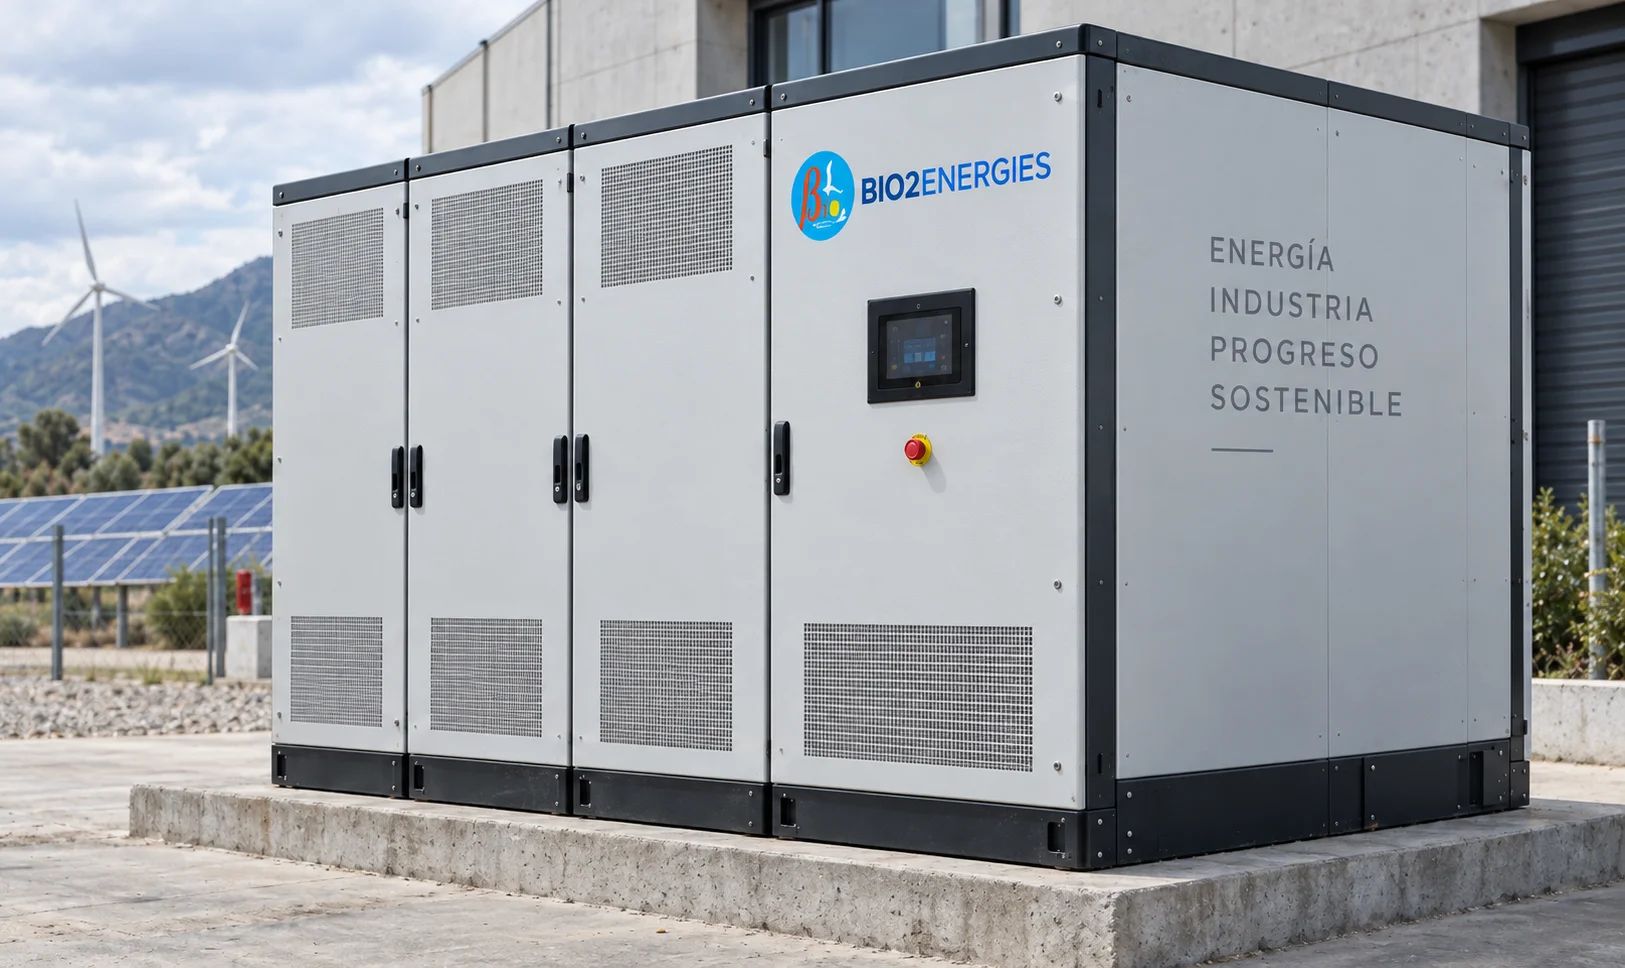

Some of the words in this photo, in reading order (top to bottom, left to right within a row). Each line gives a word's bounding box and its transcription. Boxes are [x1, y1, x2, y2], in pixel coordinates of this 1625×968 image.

[861, 151, 1051, 205] BIO2ENERGIES
[1210, 236, 1334, 272] ENERGÍA
[1210, 286, 1374, 323] INDUSTRIA
[1211, 335, 1379, 369] PROGRESO
[1210, 383, 1402, 417] SOSTENIBLE
